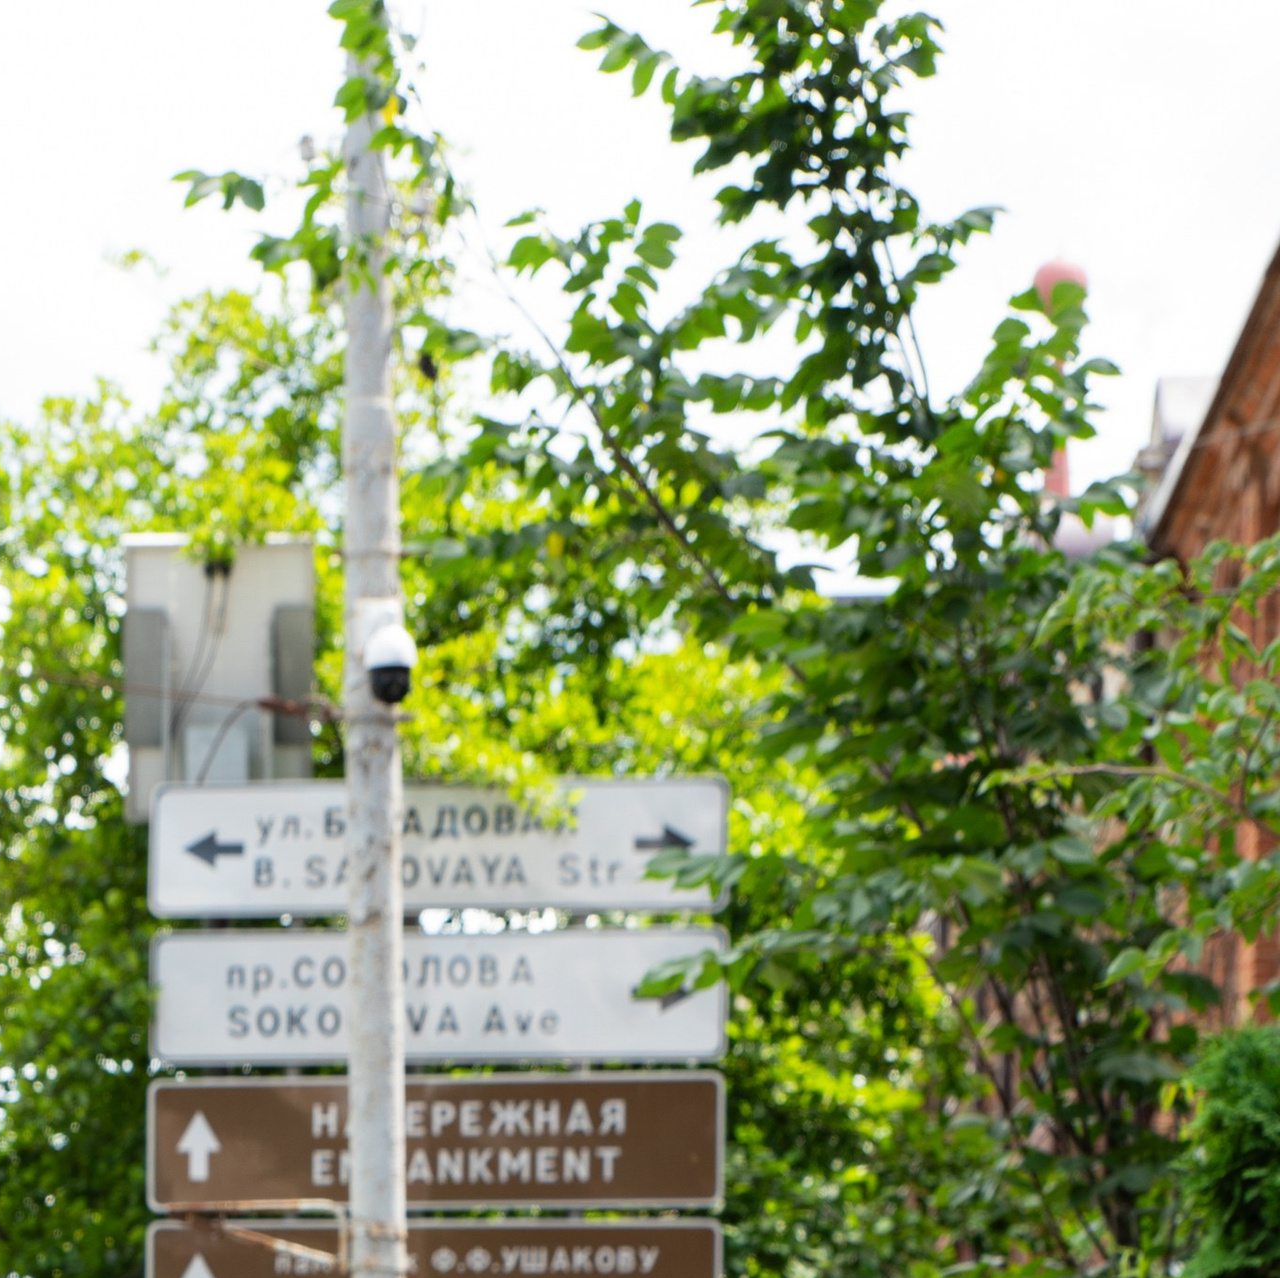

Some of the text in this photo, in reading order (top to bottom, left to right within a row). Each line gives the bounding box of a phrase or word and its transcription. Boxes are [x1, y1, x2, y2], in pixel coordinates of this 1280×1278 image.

[558, 852, 622, 887] Str
[226, 954, 534, 997] пр.СОЛОВА
[227, 1003, 561, 1038] SOKOVA Ave
[310, 1098, 627, 1138] НЕРЕЖНАЯ
[310, 1145, 622, 1186] EANKMENT
